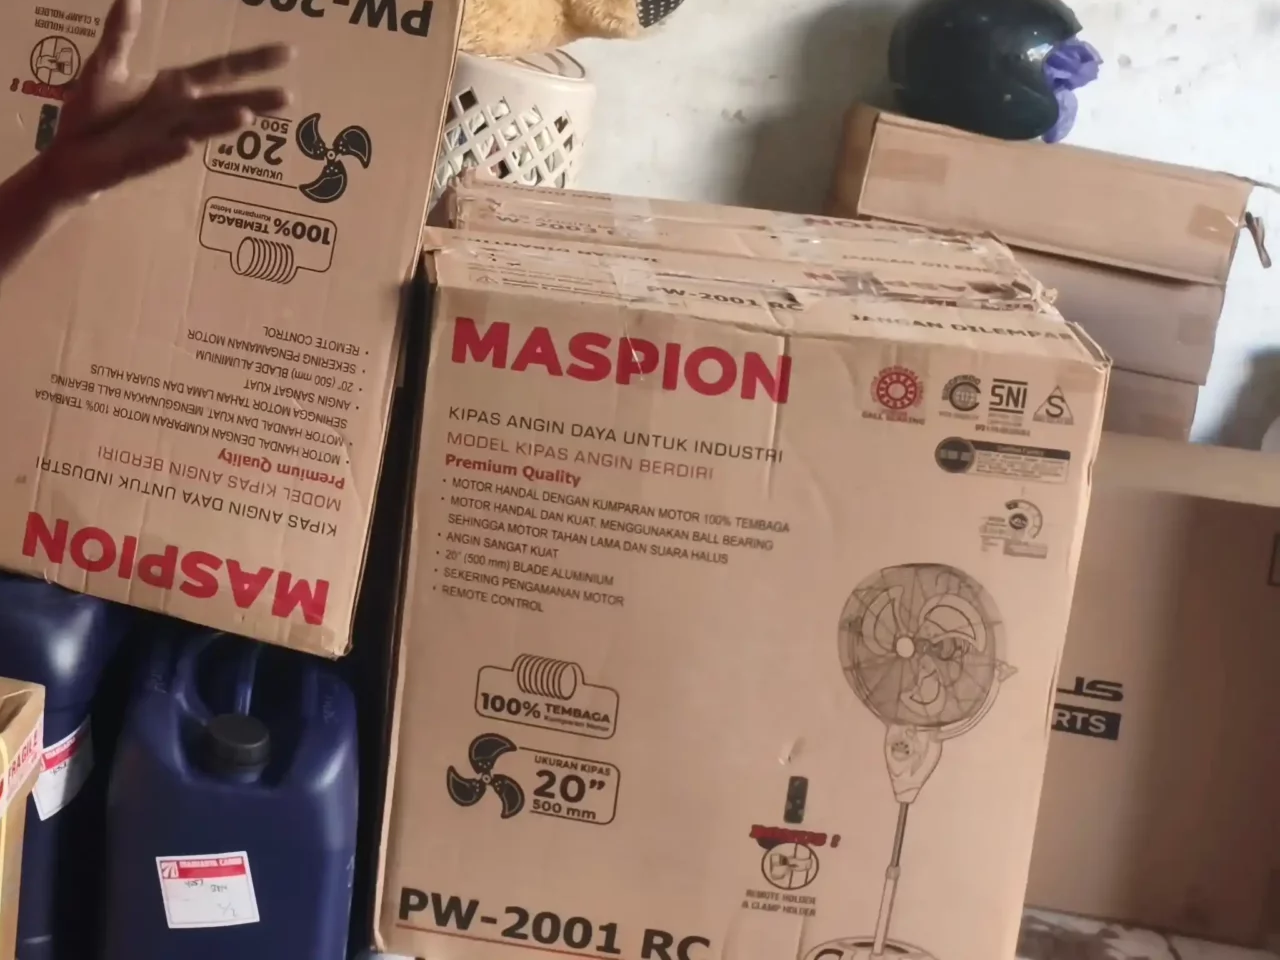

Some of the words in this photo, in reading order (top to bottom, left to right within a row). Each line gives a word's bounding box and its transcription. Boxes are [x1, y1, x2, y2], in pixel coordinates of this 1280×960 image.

[34, 6, 65, 19] HOLDER
[65, 13, 92, 25] CLAMP
[34, 18, 65, 32] HOLDER
[66, 25, 96, 38] REMOTE
[260, 119, 289, 134] 500
[211, 158, 240, 172] KIPAS
[241, 165, 283, 181] UKURAN
[210, 203, 232, 214] Motor
[233, 208, 271, 222] Kumparan
[208, 212, 270, 234] TEMBAGA
[274, 217, 331, 245] 100%
[646, 285, 759, 307] PW-2001
[768, 301, 804, 312] RC
[187, 328, 225, 346] MOTOR
[262, 325, 312, 345] CONTROL
[227, 338, 300, 363] PENGAMANAN
[316, 337, 360, 356] REMOTE
[195, 349, 254, 366] ALUMINIUM
[303, 357, 357, 374] SEKERING
[451, 316, 792, 404] MASPION
[90, 364, 124, 380] HALUS
[255, 361, 288, 379] BLADE
[291, 367, 312, 381] mm)
[50, 373, 95, 392] BEARING
[97, 383, 121, 398] BALL
[126, 375, 160, 388] SUARA
[162, 380, 186, 393] DAN
[243, 378, 271, 393] KUAT
[314, 375, 336, 388] (500
[35, 389, 83, 408] TEMBAGA
[187, 385, 214, 400] LAMA
[216, 392, 250, 407] TAHAN
[273, 387, 315, 403] SANGAT
[318, 395, 351, 410] ANGIN
[989, 385, 1028, 409] SNI
[86, 399, 109, 414] 100%
[124, 391, 203, 416] MENGGUNAKAN
[253, 399, 291, 416] MOTOR
[1045, 395, 1065, 418] S
[113, 406, 150, 423] MOTOR
[236, 416, 259, 429] DAN
[293, 408, 348, 429] SEHINGGA
[152, 415, 210, 437] KUMPARAN
[261, 419, 302, 437] HANDAL
[448, 406, 501, 426] KIPAS
[506, 415, 565, 435] ANGIN
[571, 423, 617, 442] DAYA
[623, 430, 688, 452] UNTUK
[694, 440, 783, 463] INDUSTRI
[212, 428, 256, 447] DENGAN
[259, 438, 299, 455] HANDAL
[305, 428, 344, 446] MOTOR
[98, 445, 164, 471] BERDIRI
[217, 447, 272, 473] Quality
[302, 448, 341, 465] MOTOR
[447, 431, 510, 453] MODEL
[515, 441, 569, 461] KIPAS
[574, 450, 633, 471] ANGIN
[639, 458, 714, 480] BERDIRI
[35, 456, 113, 485] INDUSTRI
[169, 462, 223, 484] ANGIN
[276, 463, 346, 490] Premium
[445, 453, 517, 476] Premium
[522, 465, 581, 488] Quality
[118, 475, 177, 500] UNTUK
[228, 475, 277, 497] KIPAS
[182, 489, 224, 511] DAYA
[283, 486, 342, 512] MODEL
[452, 477, 493, 493] MOTOR
[495, 483, 540, 501] HANDAL
[542, 490, 589, 507] DENGAN
[592, 498, 655, 517] KUMPARAN
[658, 507, 700, 523] MOTOR
[704, 513, 732, 527] 100%
[735, 516, 790, 533] TEMBAGA
[228, 500, 283, 524] ANGIN
[287, 514, 338, 537] KIPAS
[450, 495, 491, 511] MOTOR
[493, 502, 538, 519] HANDAL
[540, 509, 564, 523] DAN
[600, 518, 689, 540] MENGGUNAKAN
[692, 531, 718, 544] BALL
[722, 534, 773, 551] BEARING
[446, 531, 481, 546] ANGIN
[483, 537, 528, 554] SANGAT
[530, 546, 559, 559] KUAT
[447, 513, 505, 532] SEHINGGA
[507, 523, 549, 539] MOTOR
[551, 530, 588, 545] TAHAN
[590, 536, 621, 550] LAMA
[623, 540, 647, 554] DAN
[650, 545, 688, 559] SUARA
[691, 550, 728, 564] HALUS
[22, 511, 330, 626] MASPION
[463, 553, 486, 565] (500
[488, 558, 511, 572] mm)
[513, 561, 549, 577] BLADE
[551, 568, 614, 586] ALUMINIUM
[443, 567, 499, 586] SEKERING
[502, 577, 580, 600] PENGAMANAN
[583, 592, 624, 607] MOTOR
[442, 584, 489, 602] REMOTE
[491, 593, 544, 613] CONTROL
[481, 692, 541, 719] 100%
[544, 703, 611, 723] TEMBAGA
[8, 729, 38, 780] FRAGILE
[534, 755, 578, 771] UKURAN
[580, 764, 611, 777] KIPAS
[532, 799, 562, 813] 500
[566, 806, 597, 820] mm
[398, 886, 621, 955] PW-2001
[641, 928, 710, 960] RC
